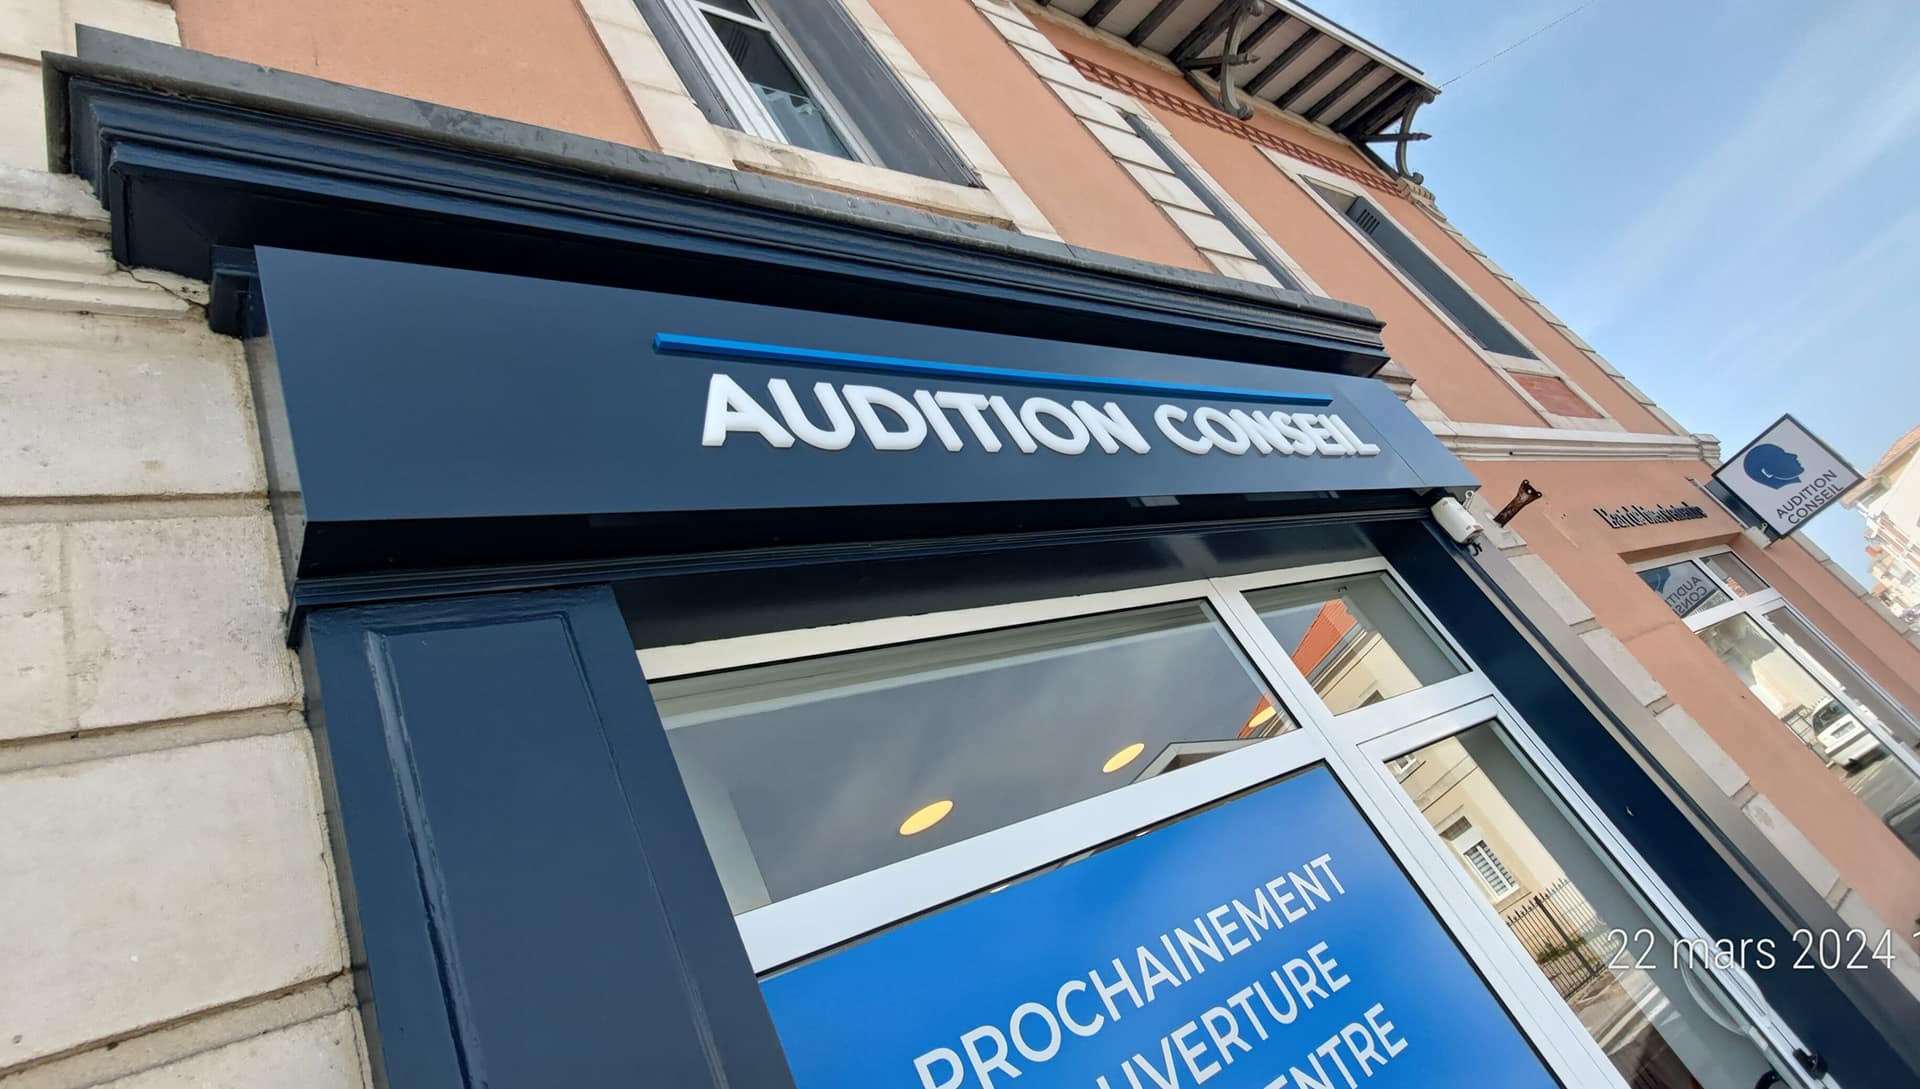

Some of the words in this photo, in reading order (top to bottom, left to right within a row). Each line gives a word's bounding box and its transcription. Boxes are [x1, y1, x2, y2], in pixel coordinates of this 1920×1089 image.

[702, 374, 1151, 454] AUDITION
[1154, 405, 1381, 456] CONSEIL
[1776, 469, 1838, 519] AUDITION
[1787, 484, 1844, 524] CONSEIL
[1261, 1002, 1409, 1089] NTRE
